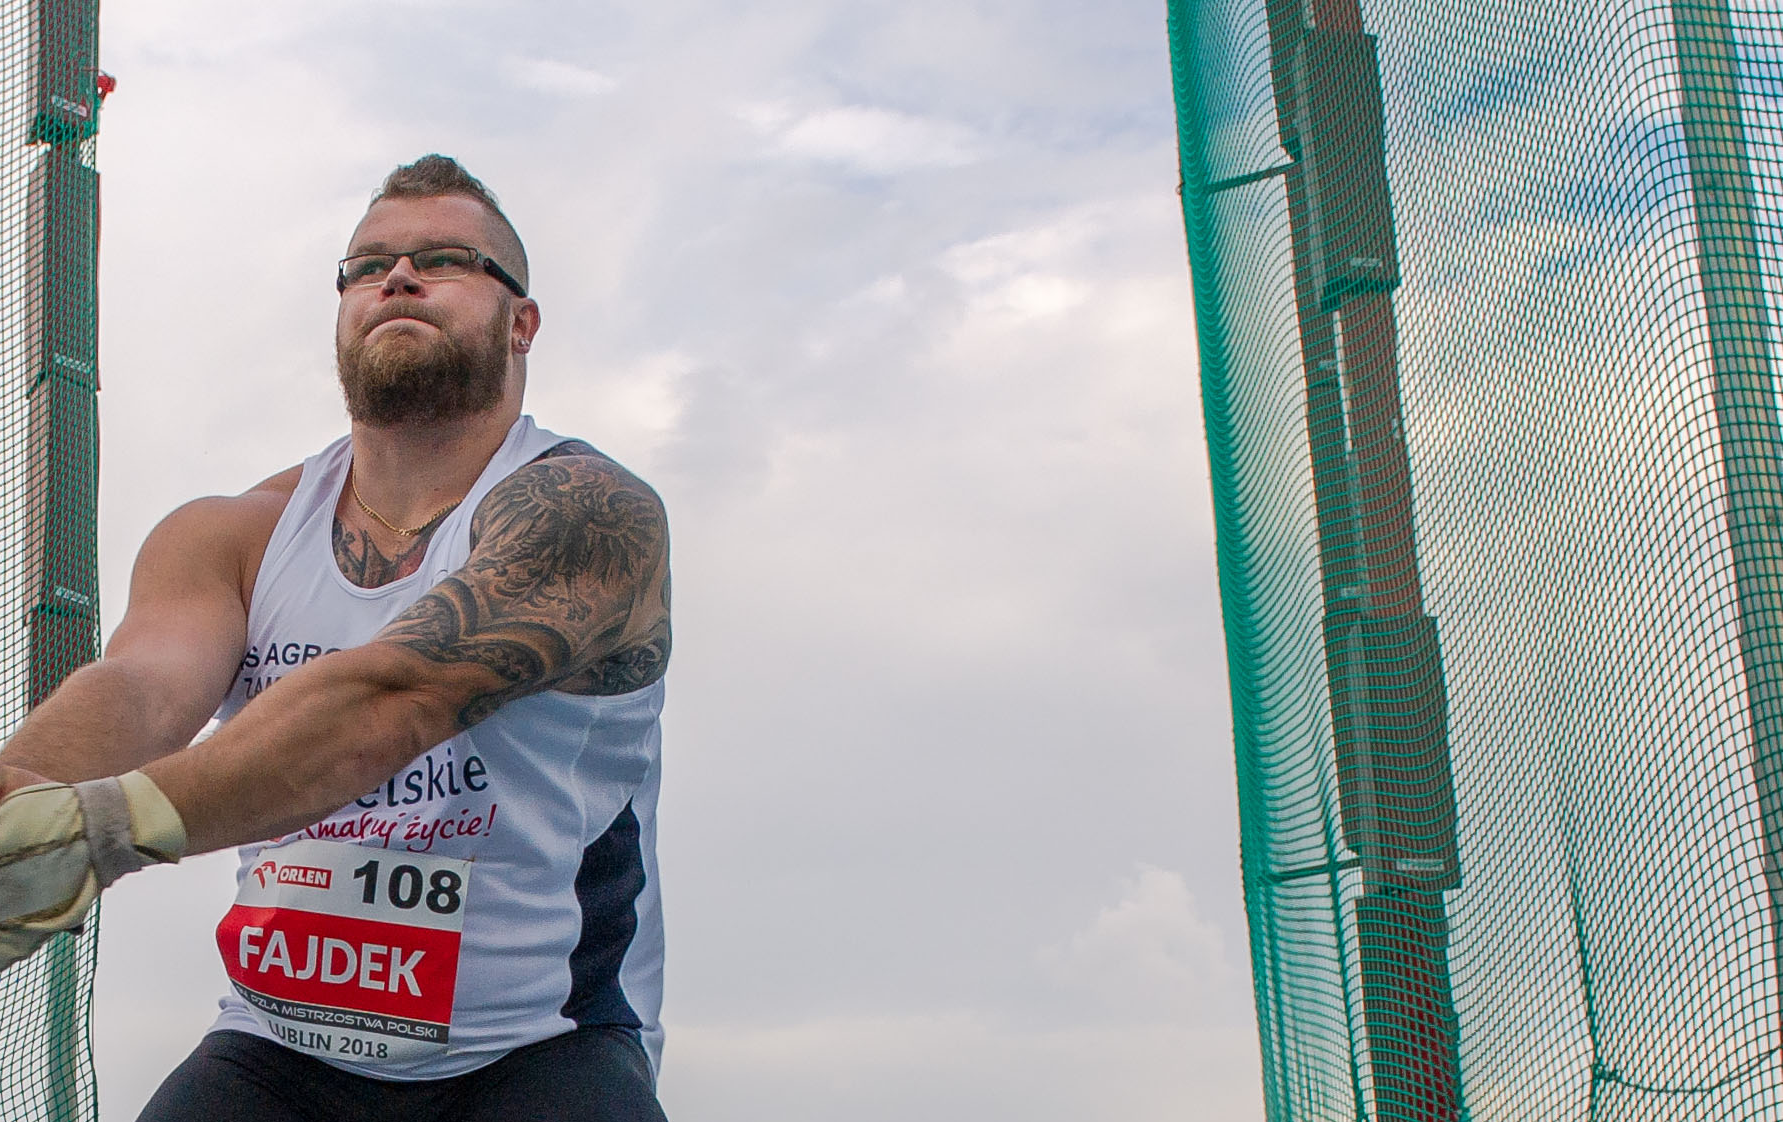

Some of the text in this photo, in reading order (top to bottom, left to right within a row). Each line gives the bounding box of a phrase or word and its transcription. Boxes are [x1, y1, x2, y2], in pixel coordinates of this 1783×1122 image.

[403, 803, 497, 852] życie!
[279, 866, 328, 886] ORLEN
[353, 860, 462, 914] 108
[239, 925, 426, 997] FAJDEK
[268, 1019, 388, 1059] LUBLIN 2018
[281, 1004, 384, 1031] MISTRZOSTWA
[386, 1023, 438, 1038] POLSKI
